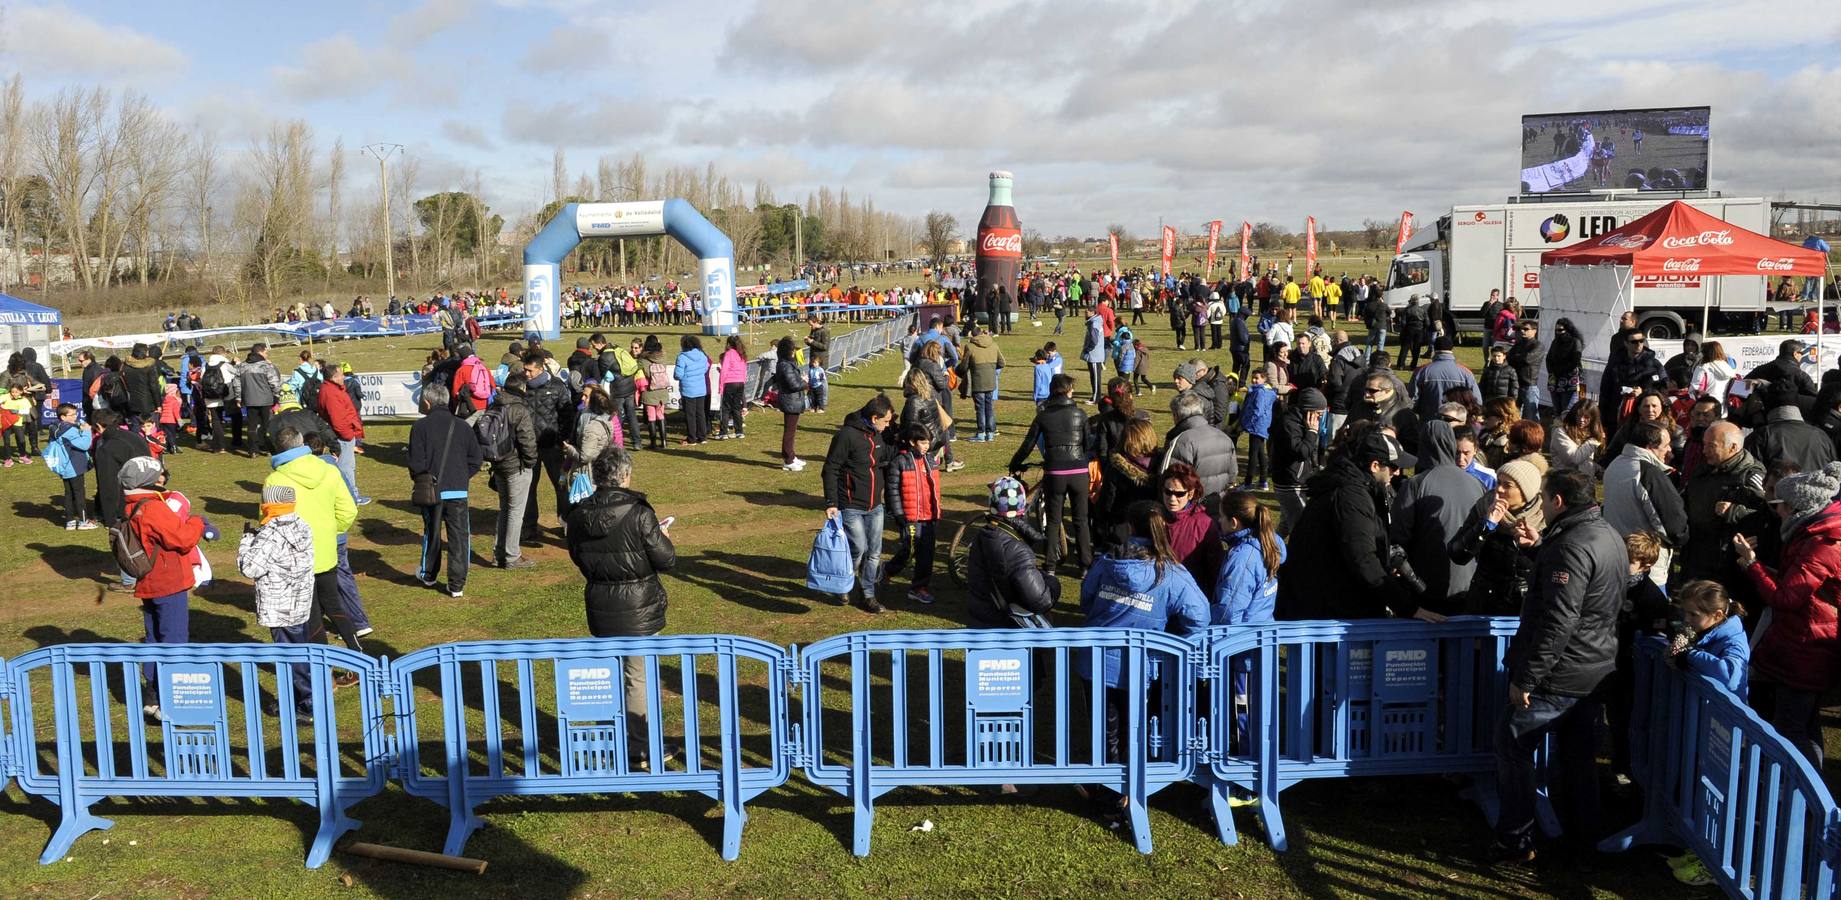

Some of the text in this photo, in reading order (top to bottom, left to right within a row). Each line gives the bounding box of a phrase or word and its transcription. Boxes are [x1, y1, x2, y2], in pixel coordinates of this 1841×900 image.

[1663, 229, 1734, 249] Coca-Cola
[1663, 258, 1703, 271] Coca-Cola
[1757, 257, 1795, 271] Coca-Cola
[529, 280, 542, 313] FMD
[708, 272, 722, 309] FMD
[0, 312, 27, 323] STILLA
[28, 312, 35, 323] Y
[364, 404, 396, 416] Y LEÓN
[1386, 650, 1427, 661] FMD
[979, 659, 1021, 671] FMD
[172, 673, 211, 684] FMD
[568, 668, 611, 680] FMD
